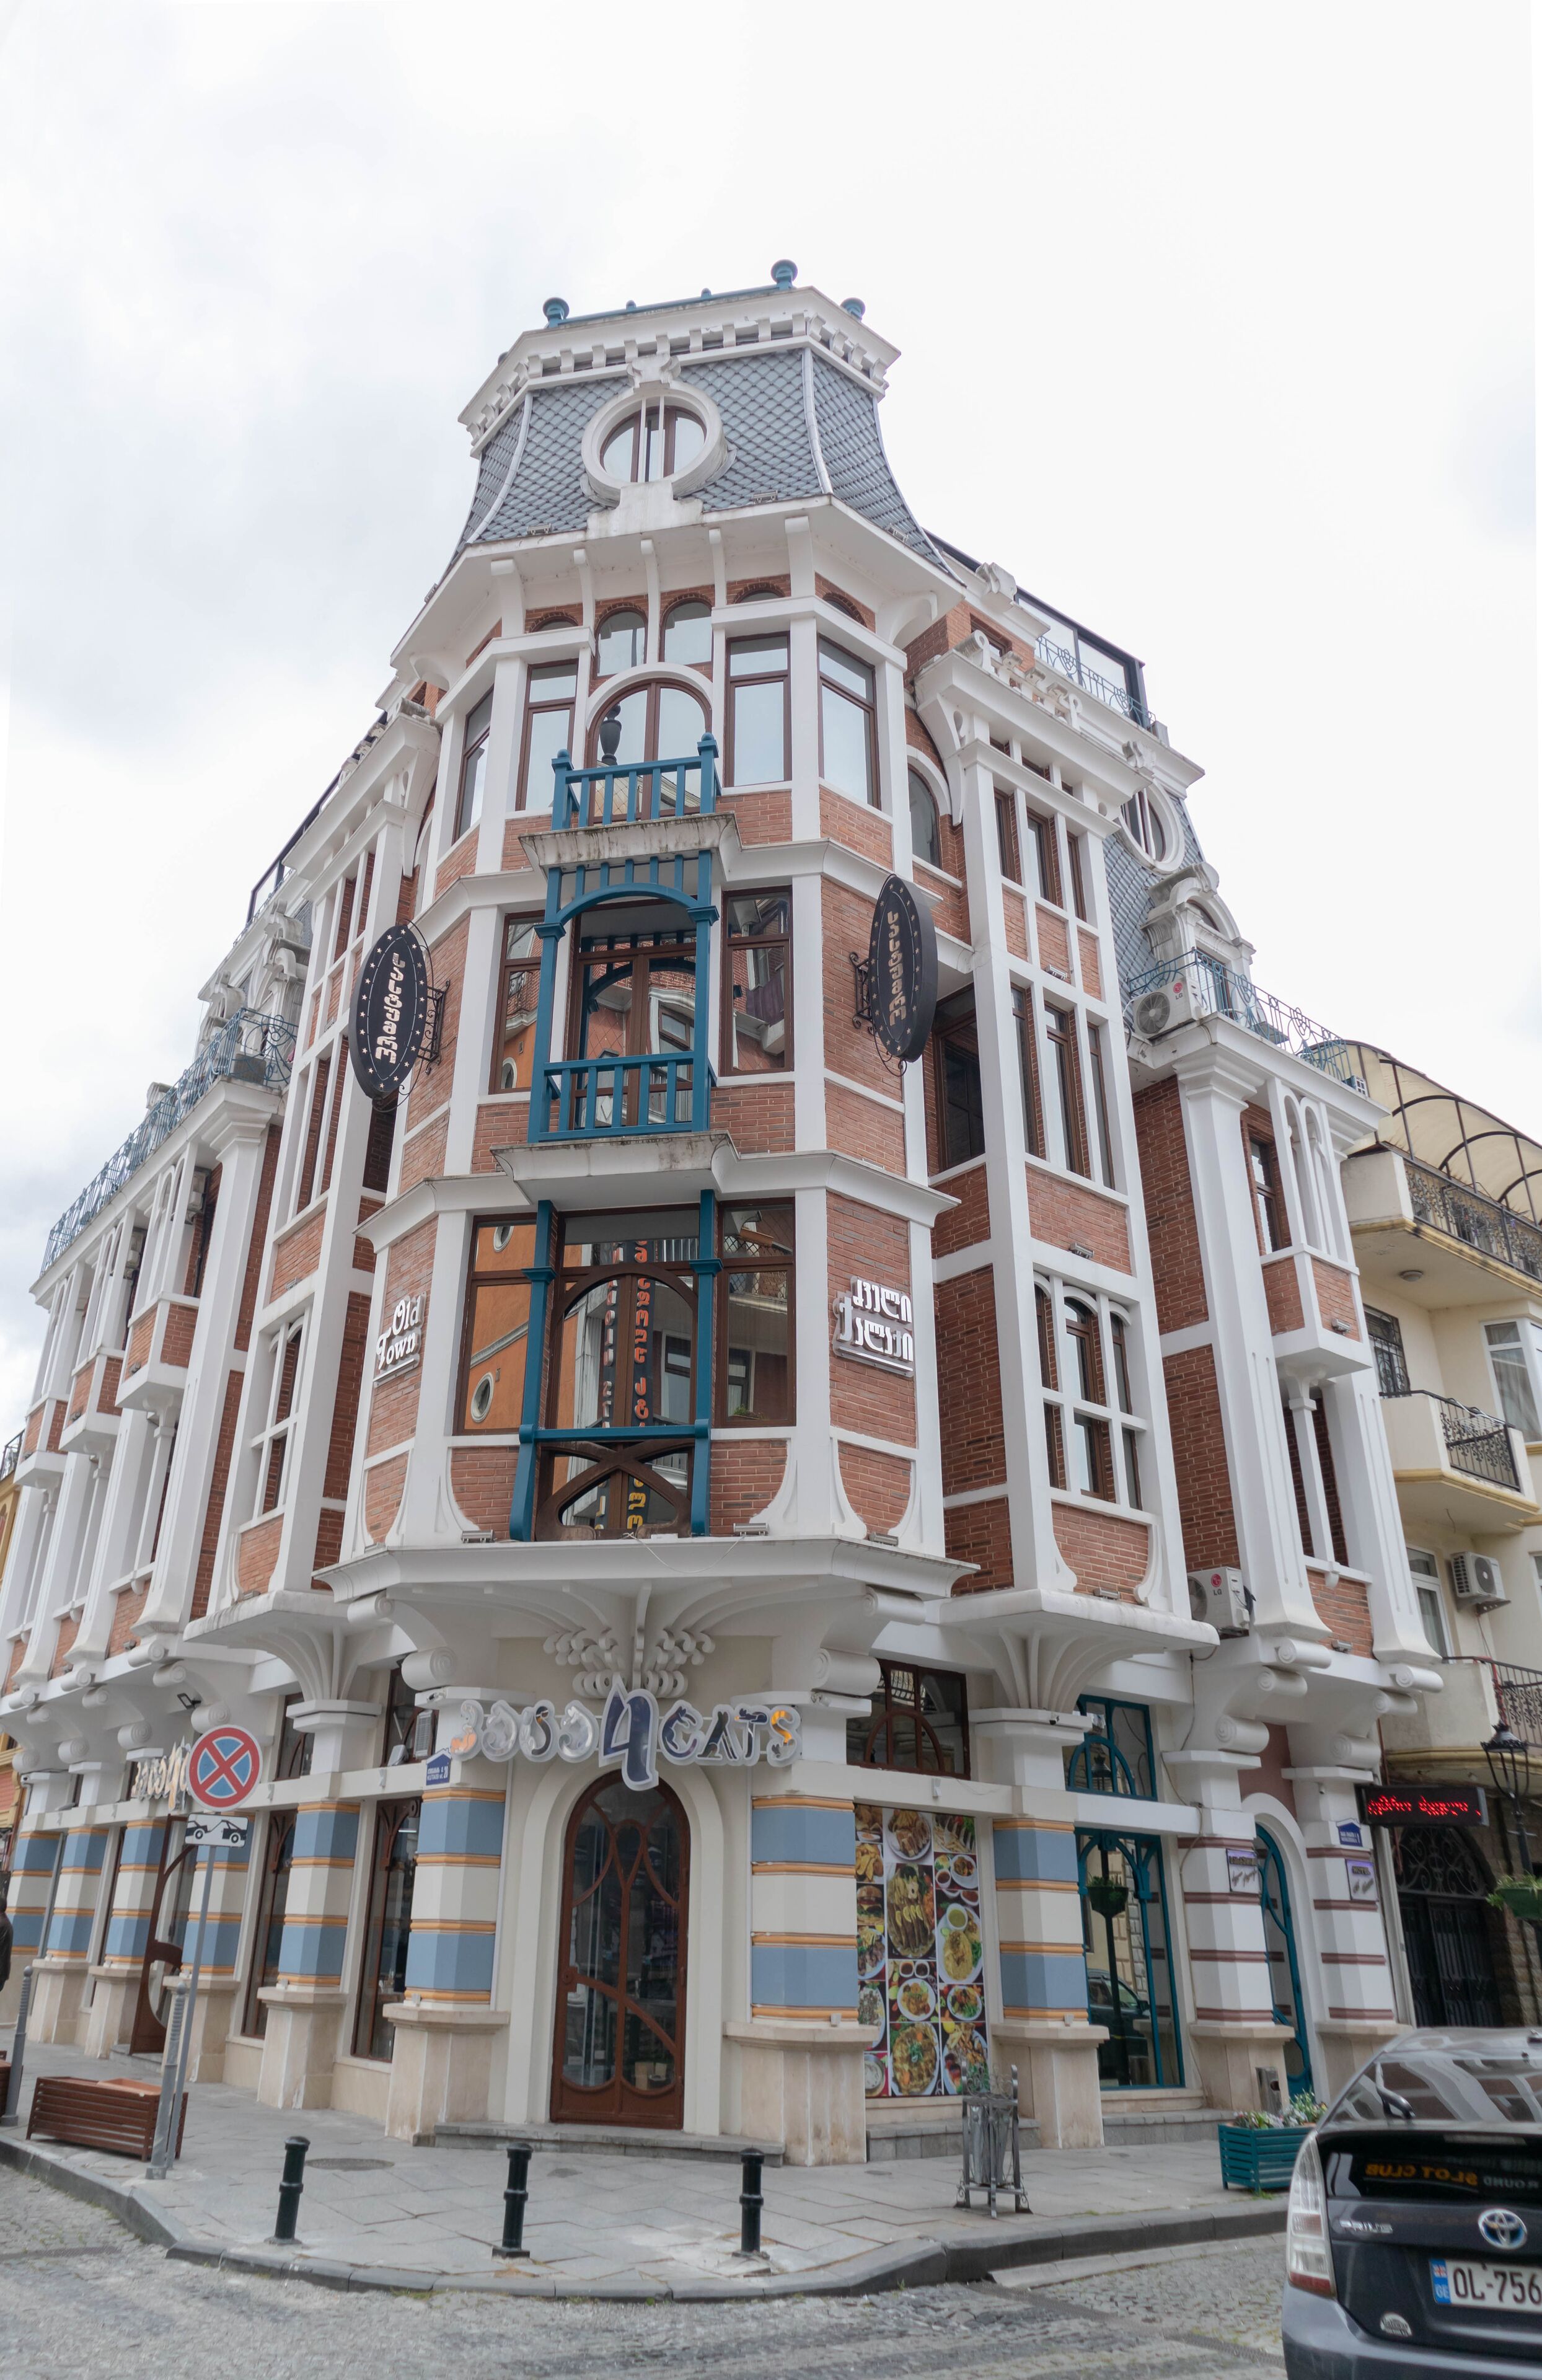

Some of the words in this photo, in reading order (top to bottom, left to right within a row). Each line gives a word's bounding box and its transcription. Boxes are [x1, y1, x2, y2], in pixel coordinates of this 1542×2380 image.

[374, 952, 406, 1064] სასტუმრო
[392, 1295, 421, 1335] Old
[853, 1279, 912, 1323] ძველი
[376, 1328, 416, 1370] Town
[839, 1297, 914, 1362] ქალაქი
[603, 1686, 654, 1783] 4
[661, 1704, 796, 1761] CATS
[1340, 2219, 1393, 2234] PRIUS
[1435, 2283, 1449, 2299] GE
